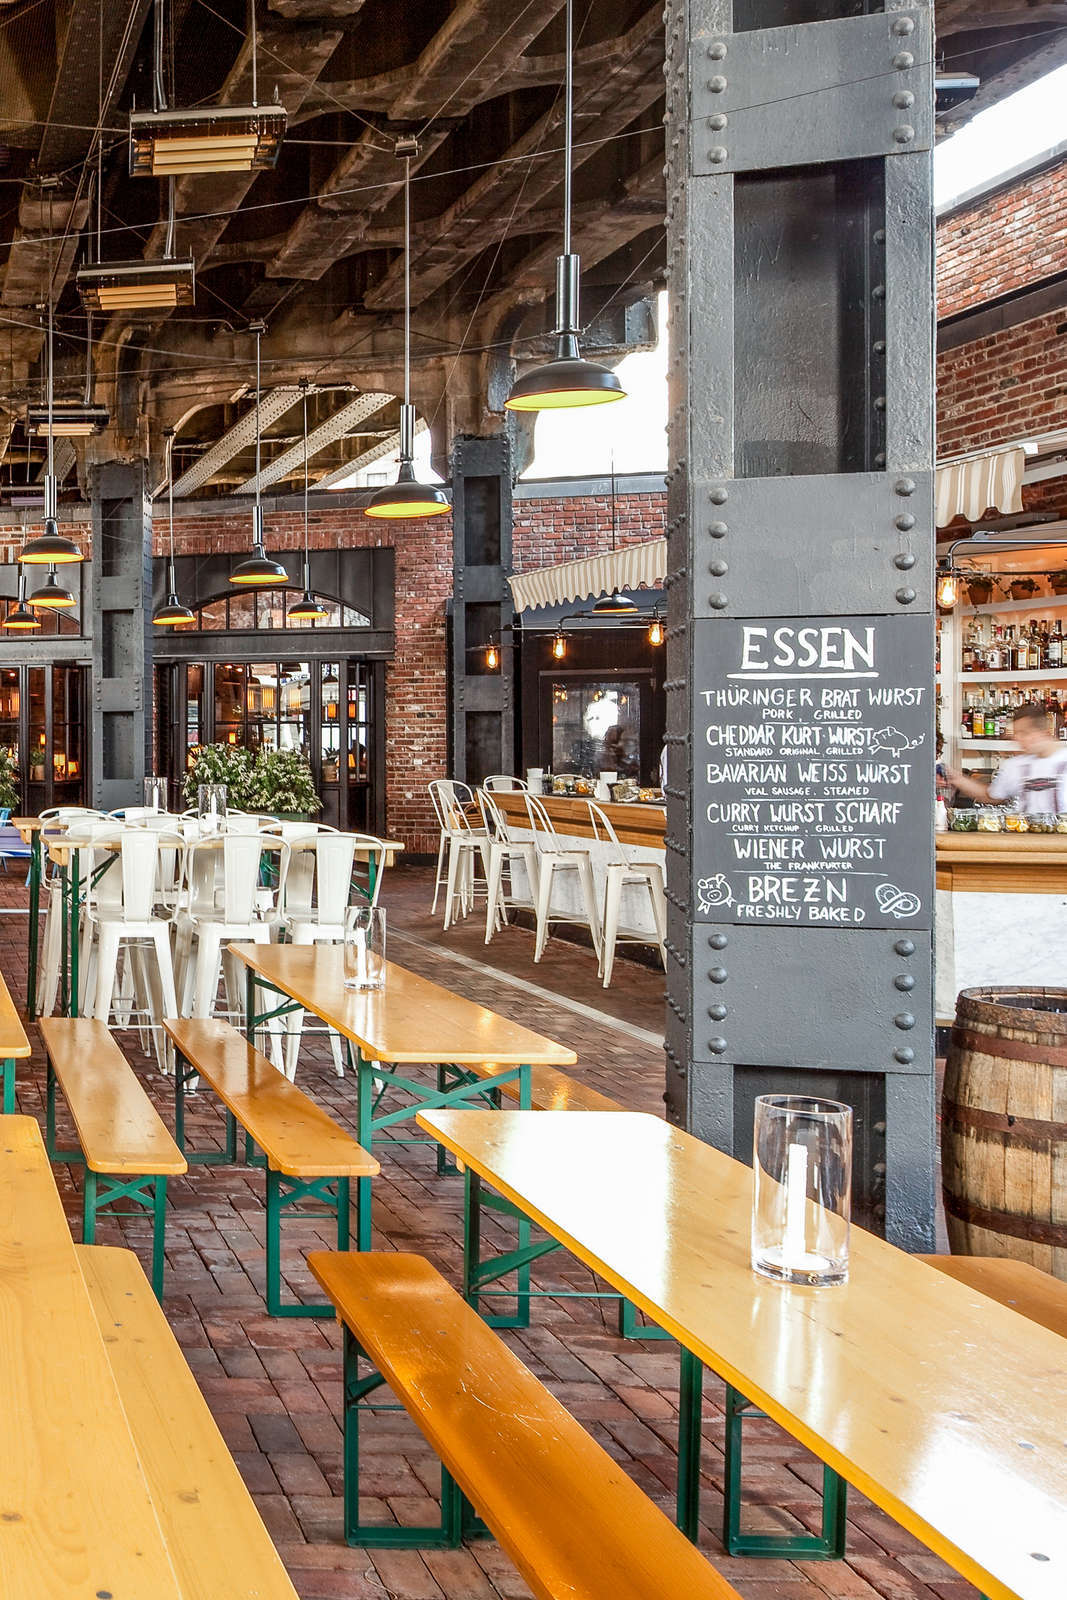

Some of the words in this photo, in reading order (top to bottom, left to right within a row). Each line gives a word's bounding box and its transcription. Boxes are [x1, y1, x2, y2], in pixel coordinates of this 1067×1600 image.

[741, 627, 875, 670] ESSEN
[700, 685, 813, 707] THÜRINGER
[821, 689, 860, 708] BRAT
[867, 687, 926, 706] WURST
[814, 709, 862, 720] GRILLED
[706, 725, 776, 746] CHEDDAR
[828, 727, 874, 746] WURST
[725, 748, 773, 756] STANDARD
[707, 764, 787, 783] BAVARIAN
[797, 764, 847, 783] WEISS
[856, 764, 912, 784] WURST
[745, 788, 768, 796] VEAL
[824, 787, 869, 796] STEAMED
[707, 803, 760, 823] CURRY
[770, 803, 825, 823] WURST
[835, 803, 903, 824] SCHARF
[815, 825, 854, 833] GRILLED
[733, 839, 805, 859] WIENER
[820, 838, 887, 859] WURST
[788, 862, 853, 870] FRANKFURTER
[737, 905, 802, 919] FRESHLY
[809, 907, 865, 922] BAKED
